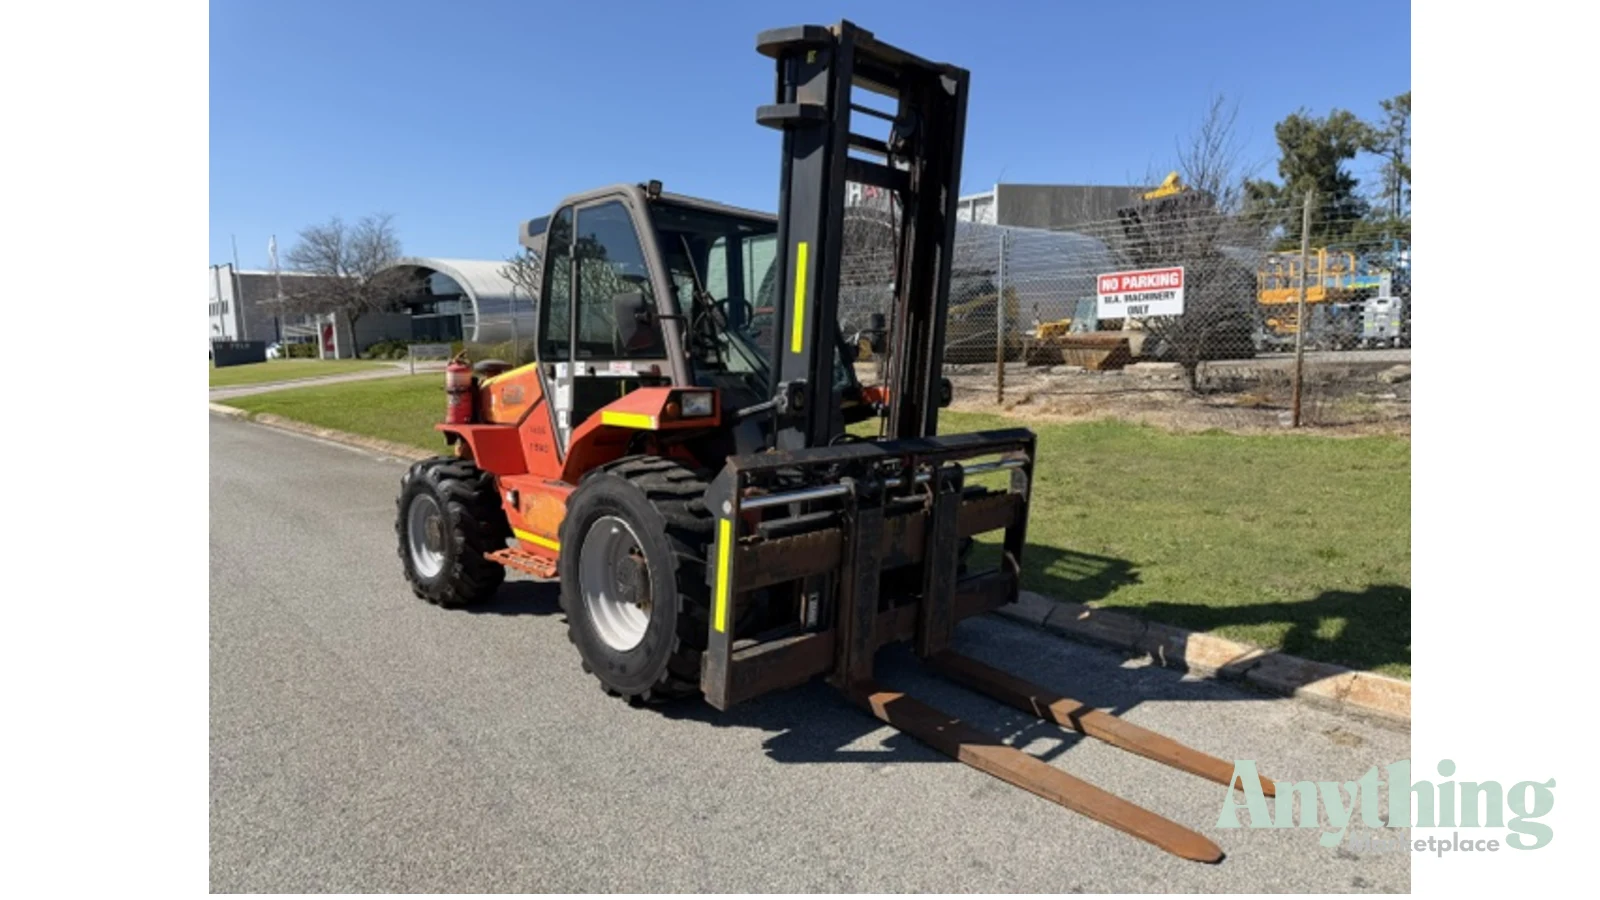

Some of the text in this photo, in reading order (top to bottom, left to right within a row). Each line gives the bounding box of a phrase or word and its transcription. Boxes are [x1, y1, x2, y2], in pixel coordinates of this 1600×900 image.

[1102, 272, 1179, 292] NO PARKING
[1124, 291, 1176, 303] MACHINERY
[1127, 304, 1150, 315] ONLY
